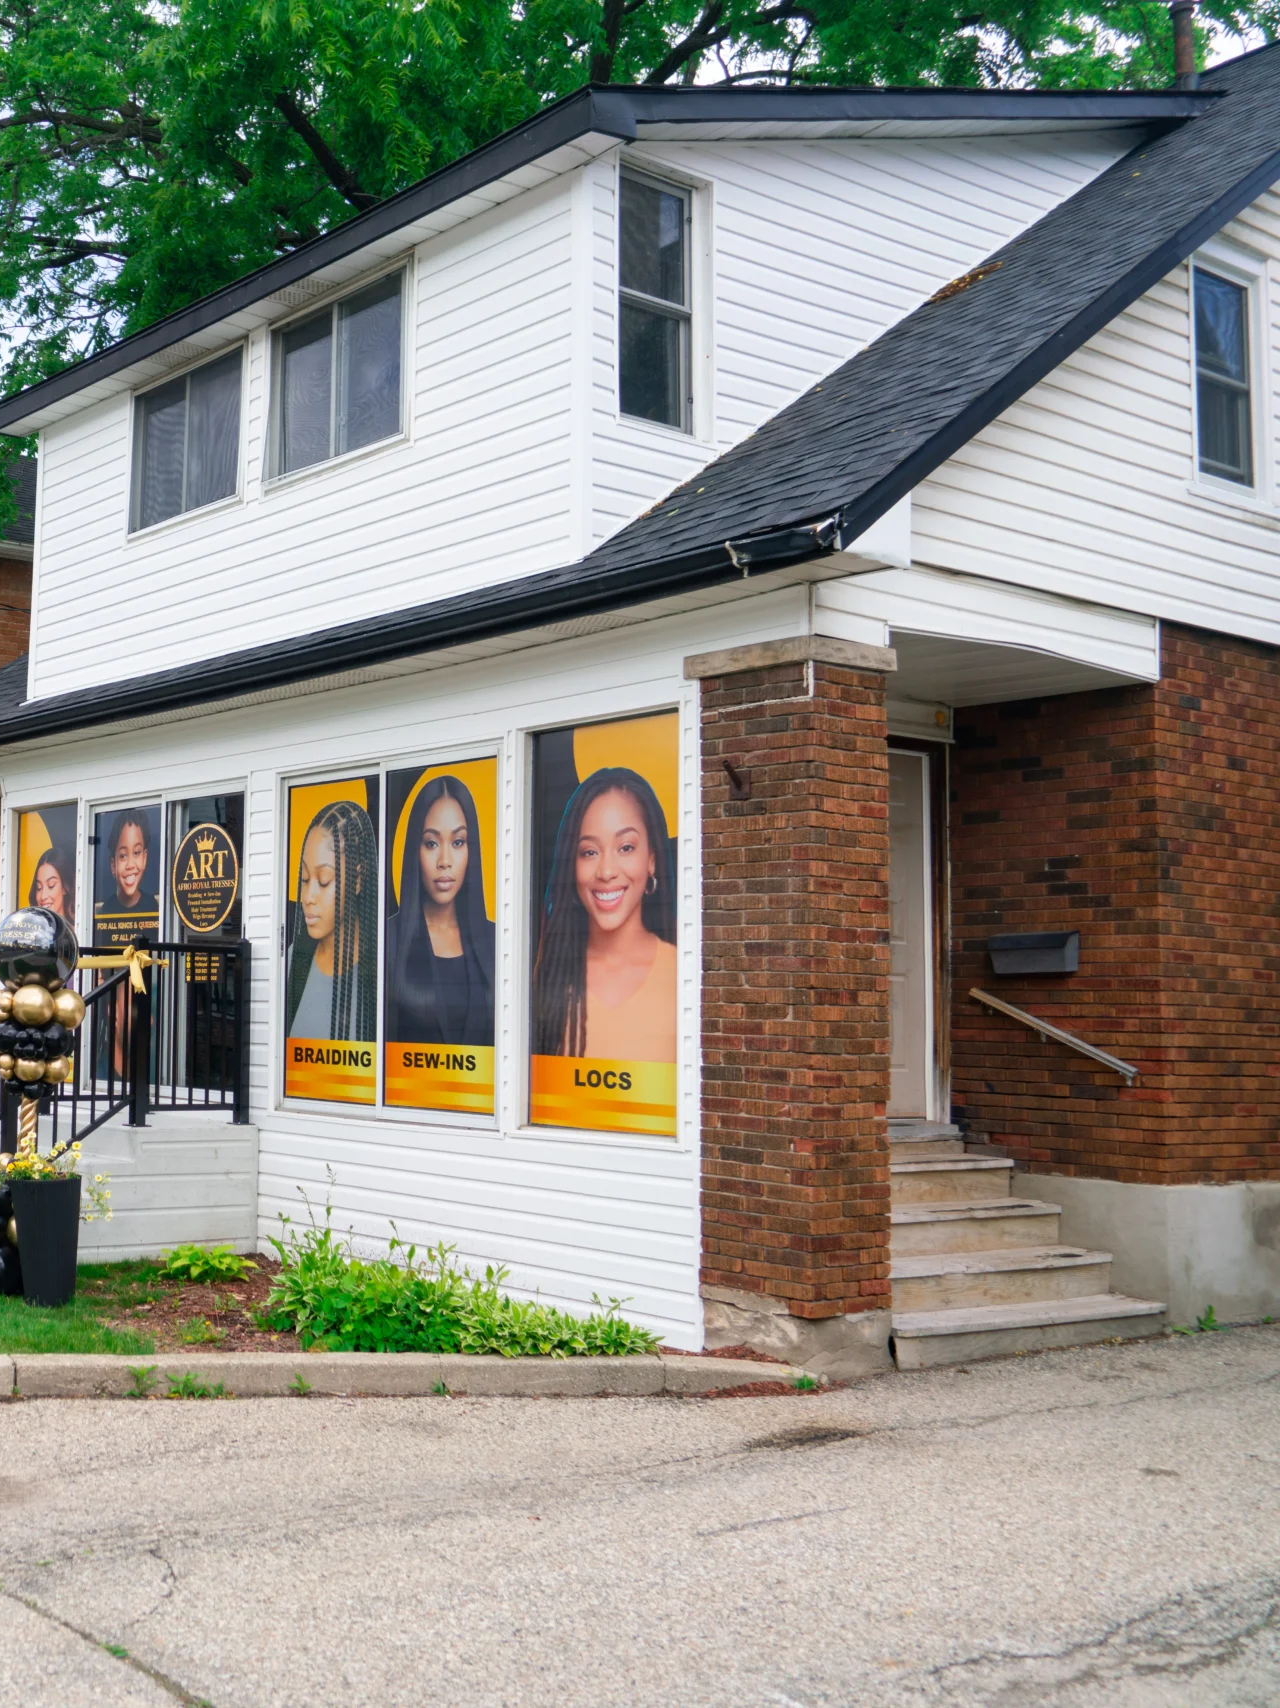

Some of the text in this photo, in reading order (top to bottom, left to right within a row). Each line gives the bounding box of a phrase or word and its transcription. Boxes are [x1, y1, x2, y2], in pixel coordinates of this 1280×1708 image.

[183, 850, 228, 880] ART
[177, 879, 235, 891] AFRO ROYAL TRESSES
[97, 922, 108, 930] FOR
[108, 922, 118, 930] ALL
[118, 921, 134, 929] KINGS
[138, 920, 159, 930] QUEENS
[111, 934, 119, 942] OF
[293, 1046, 372, 1068] BRAIDING
[402, 1051, 477, 1072] SEW-INS
[574, 1068, 632, 1091] LOCS
